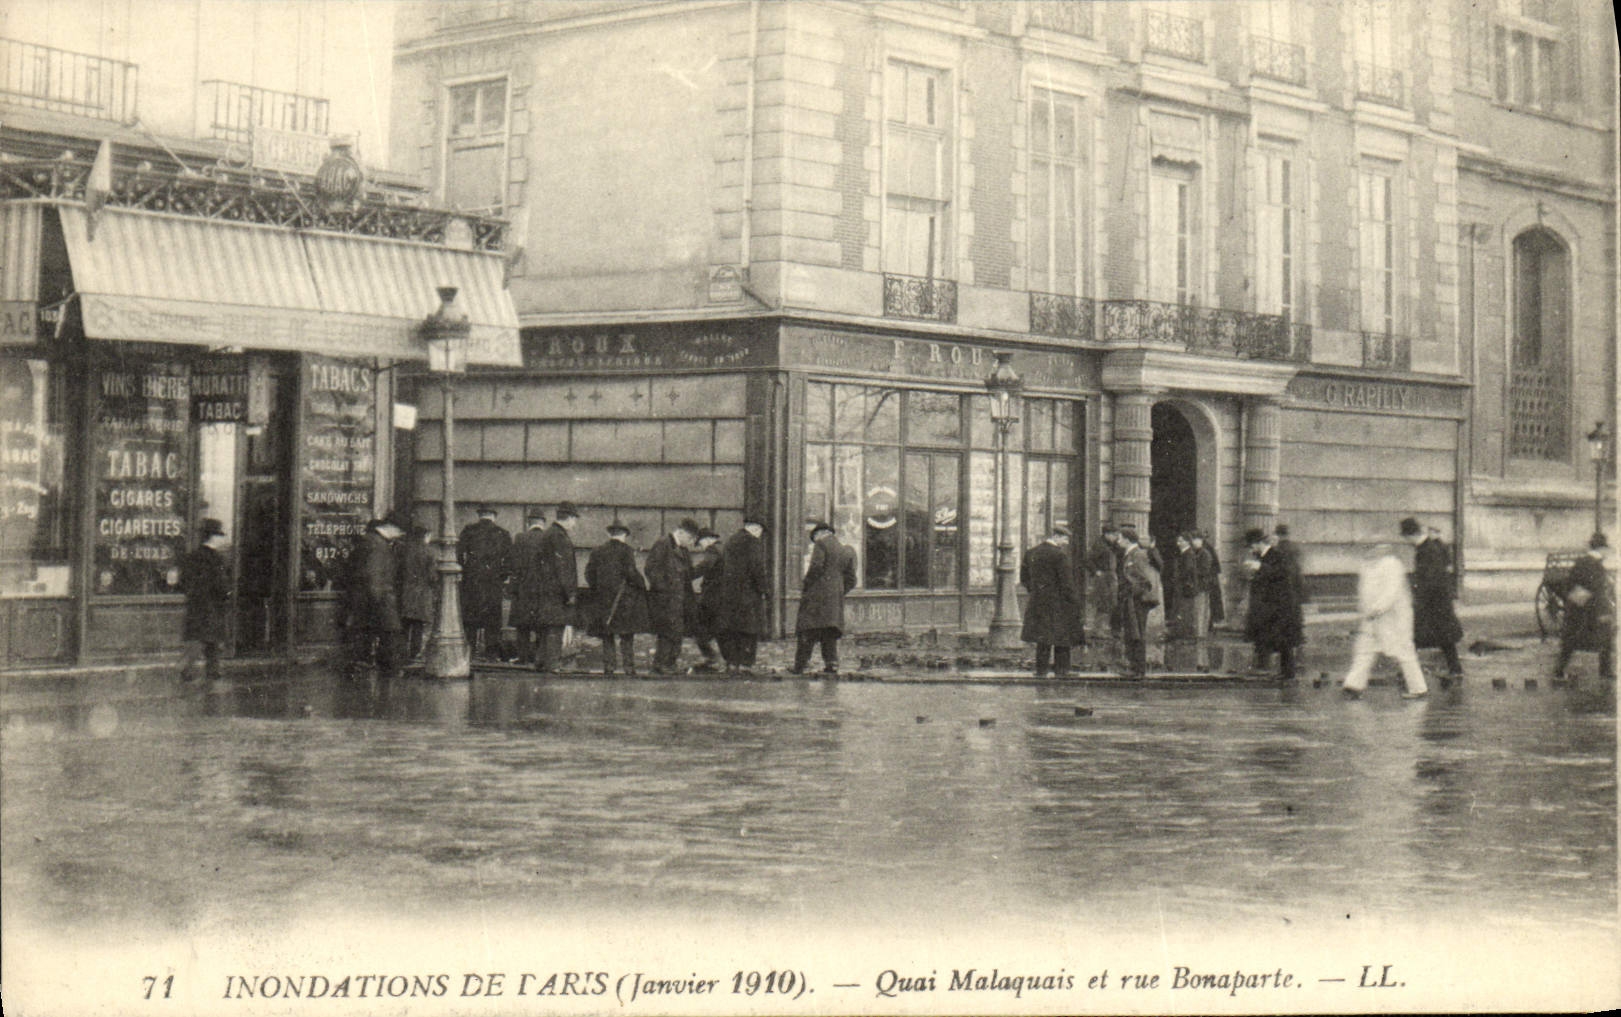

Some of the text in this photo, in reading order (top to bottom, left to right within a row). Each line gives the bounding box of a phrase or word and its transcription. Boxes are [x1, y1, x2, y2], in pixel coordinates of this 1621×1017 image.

[311, 364, 370, 392] TABACS
[199, 402, 241, 420] TABAC
[108, 450, 177, 479] TABAC
[110, 490, 173, 508] CIGARES
[100, 519, 181, 536] CIGARETTES
